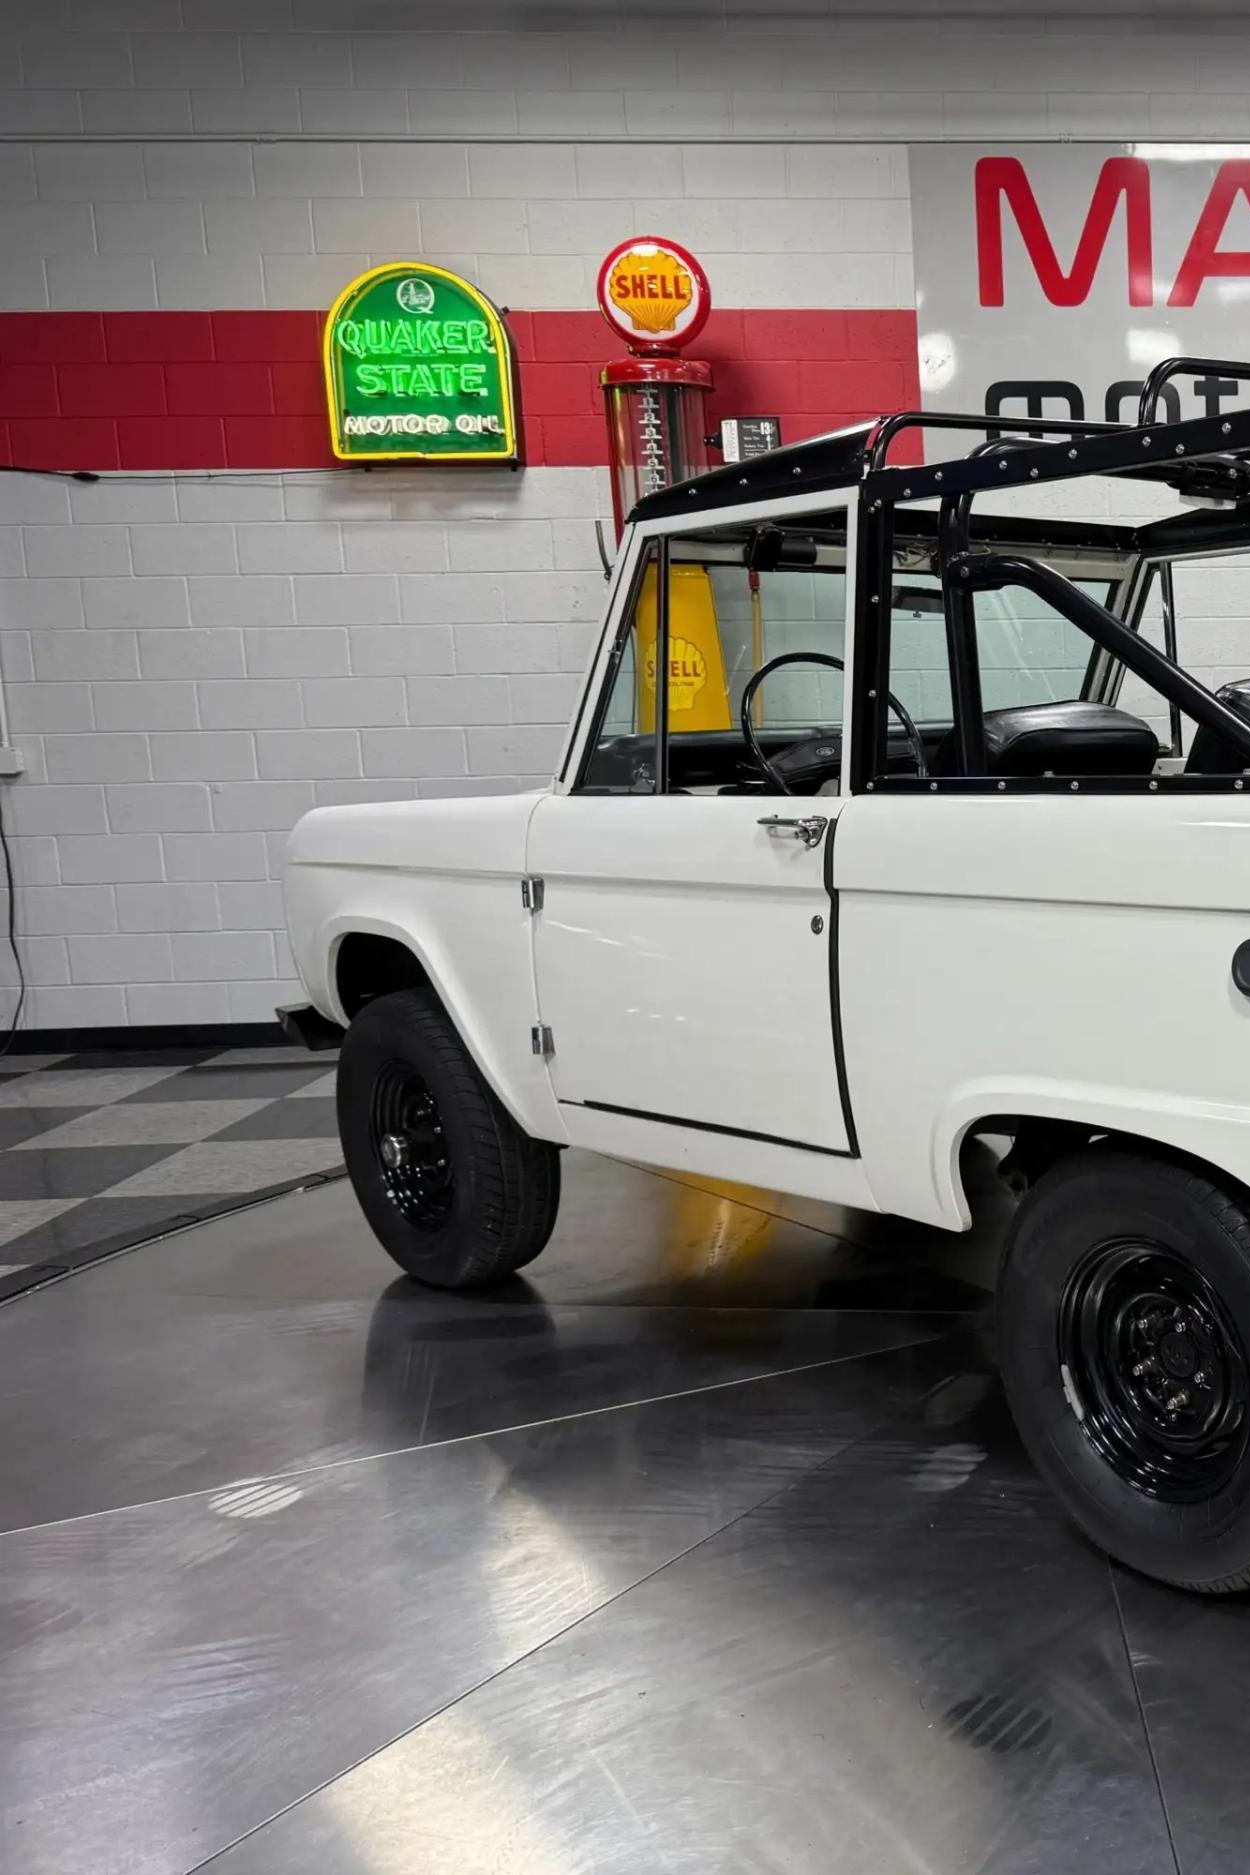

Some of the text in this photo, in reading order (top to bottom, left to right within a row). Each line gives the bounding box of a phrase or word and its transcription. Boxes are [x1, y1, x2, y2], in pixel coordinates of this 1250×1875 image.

[615, 274, 687, 300] SHELL
[337, 318, 496, 358] QUAKER
[356, 364, 488, 398] STATE
[344, 414, 505, 436] MOTOR OIL
[646, 660, 701, 678] SELL
